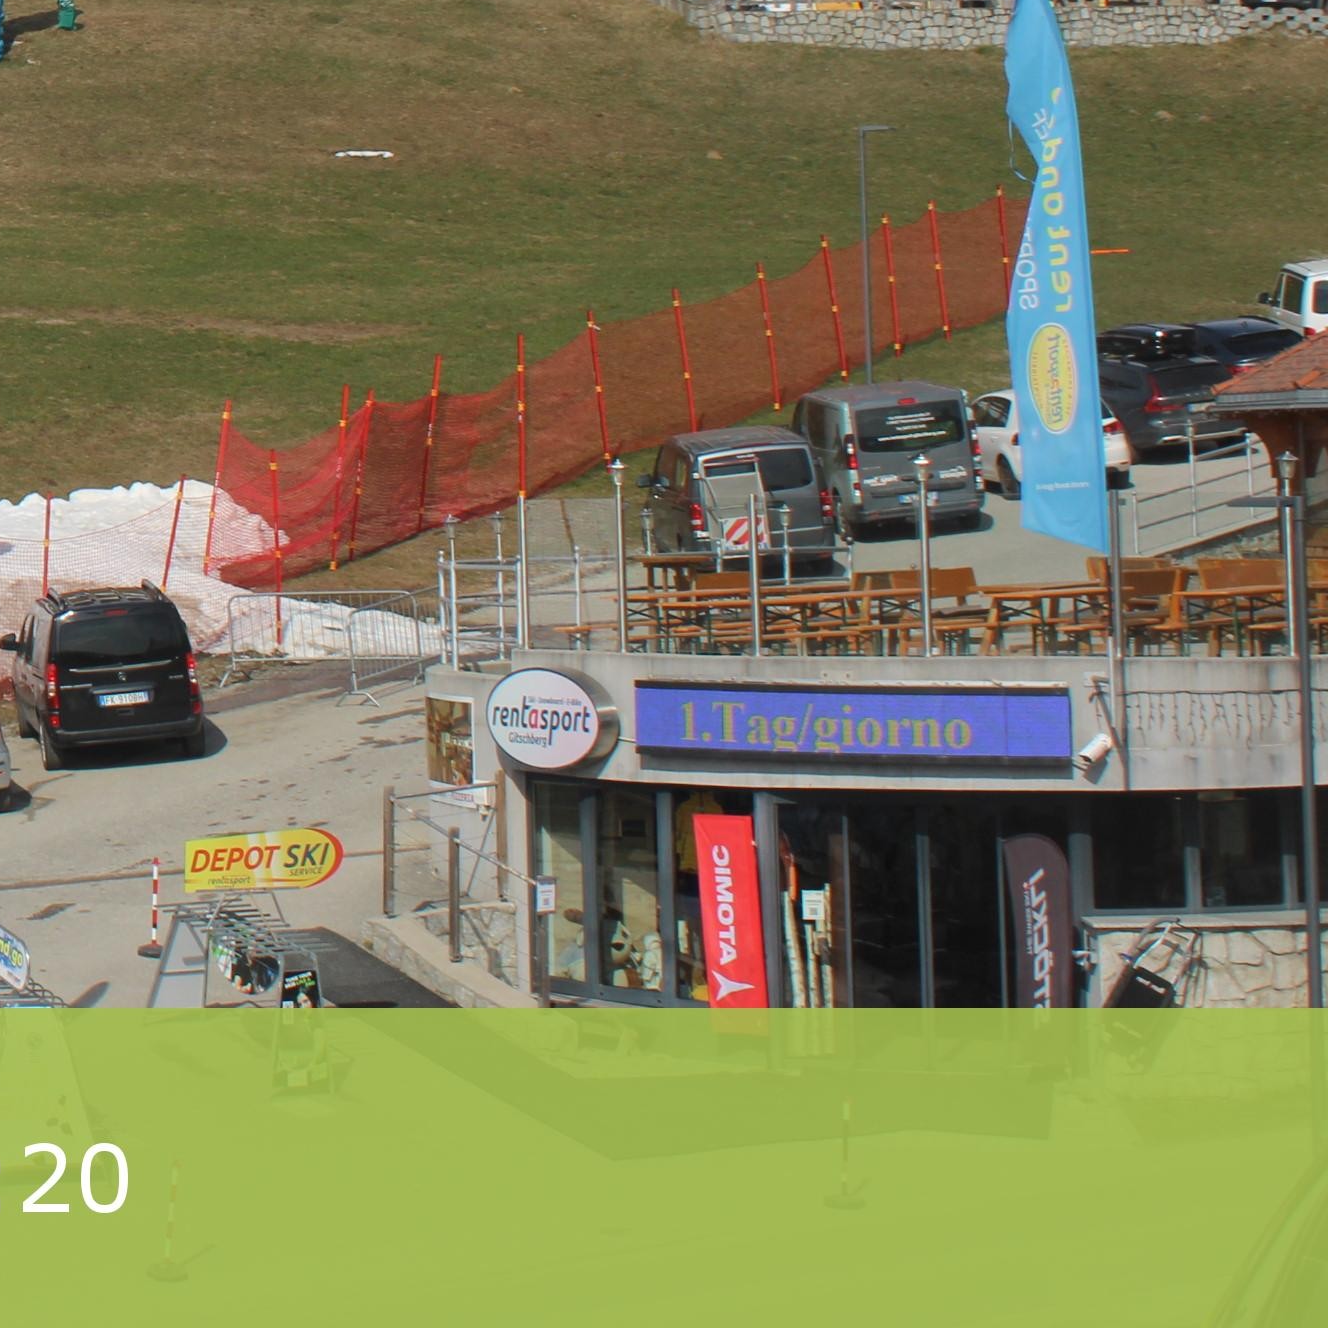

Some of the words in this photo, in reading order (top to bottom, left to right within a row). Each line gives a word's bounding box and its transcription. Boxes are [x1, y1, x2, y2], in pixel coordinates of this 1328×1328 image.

[492, 695, 591, 746] rentasport
[680, 700, 973, 754] 1.Tag/giorno
[508, 731, 548, 749] Gitschberg
[190, 845, 281, 873] DEPOT
[283, 841, 330, 869] SKI
[289, 866, 324, 877] SERVICE
[11, 949, 23, 968] go
